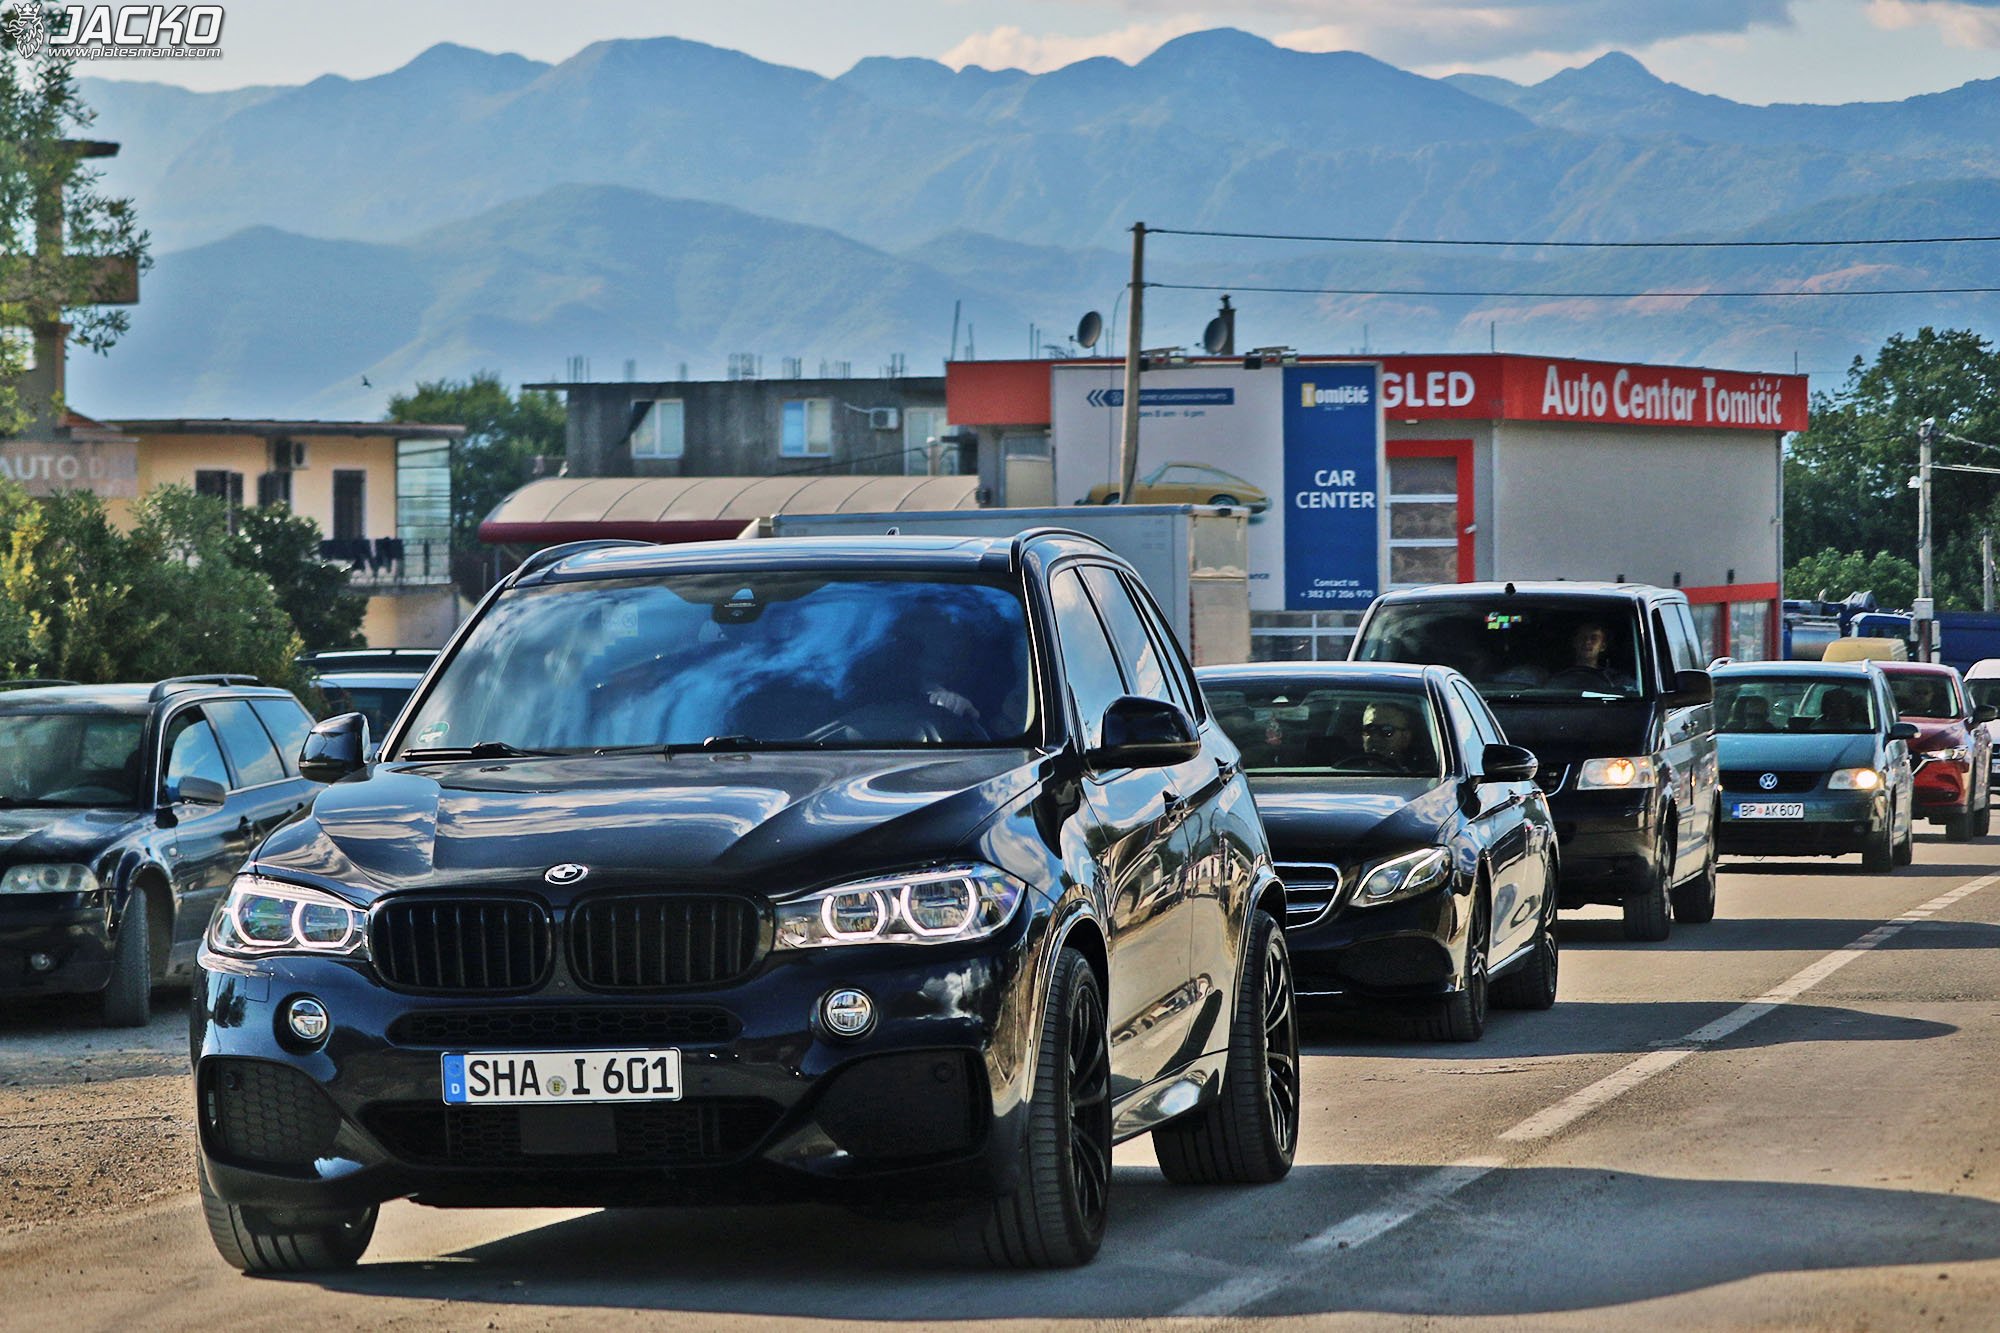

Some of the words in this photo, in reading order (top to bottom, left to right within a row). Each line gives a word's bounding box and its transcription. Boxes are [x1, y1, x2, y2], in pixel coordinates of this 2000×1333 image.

[1542, 365, 1607, 416] Auto
[1613, 368, 1697, 421] Centar
[1702, 376, 1782, 424] Tomičić
[1315, 470, 1355, 487] CAR
[1296, 492, 1375, 509] CENTER
[1314, 579, 1347, 587] Contact
[469, 1060, 541, 1097] SHA
[572, 1058, 591, 1095] I
[603, 1056, 674, 1095] 601
